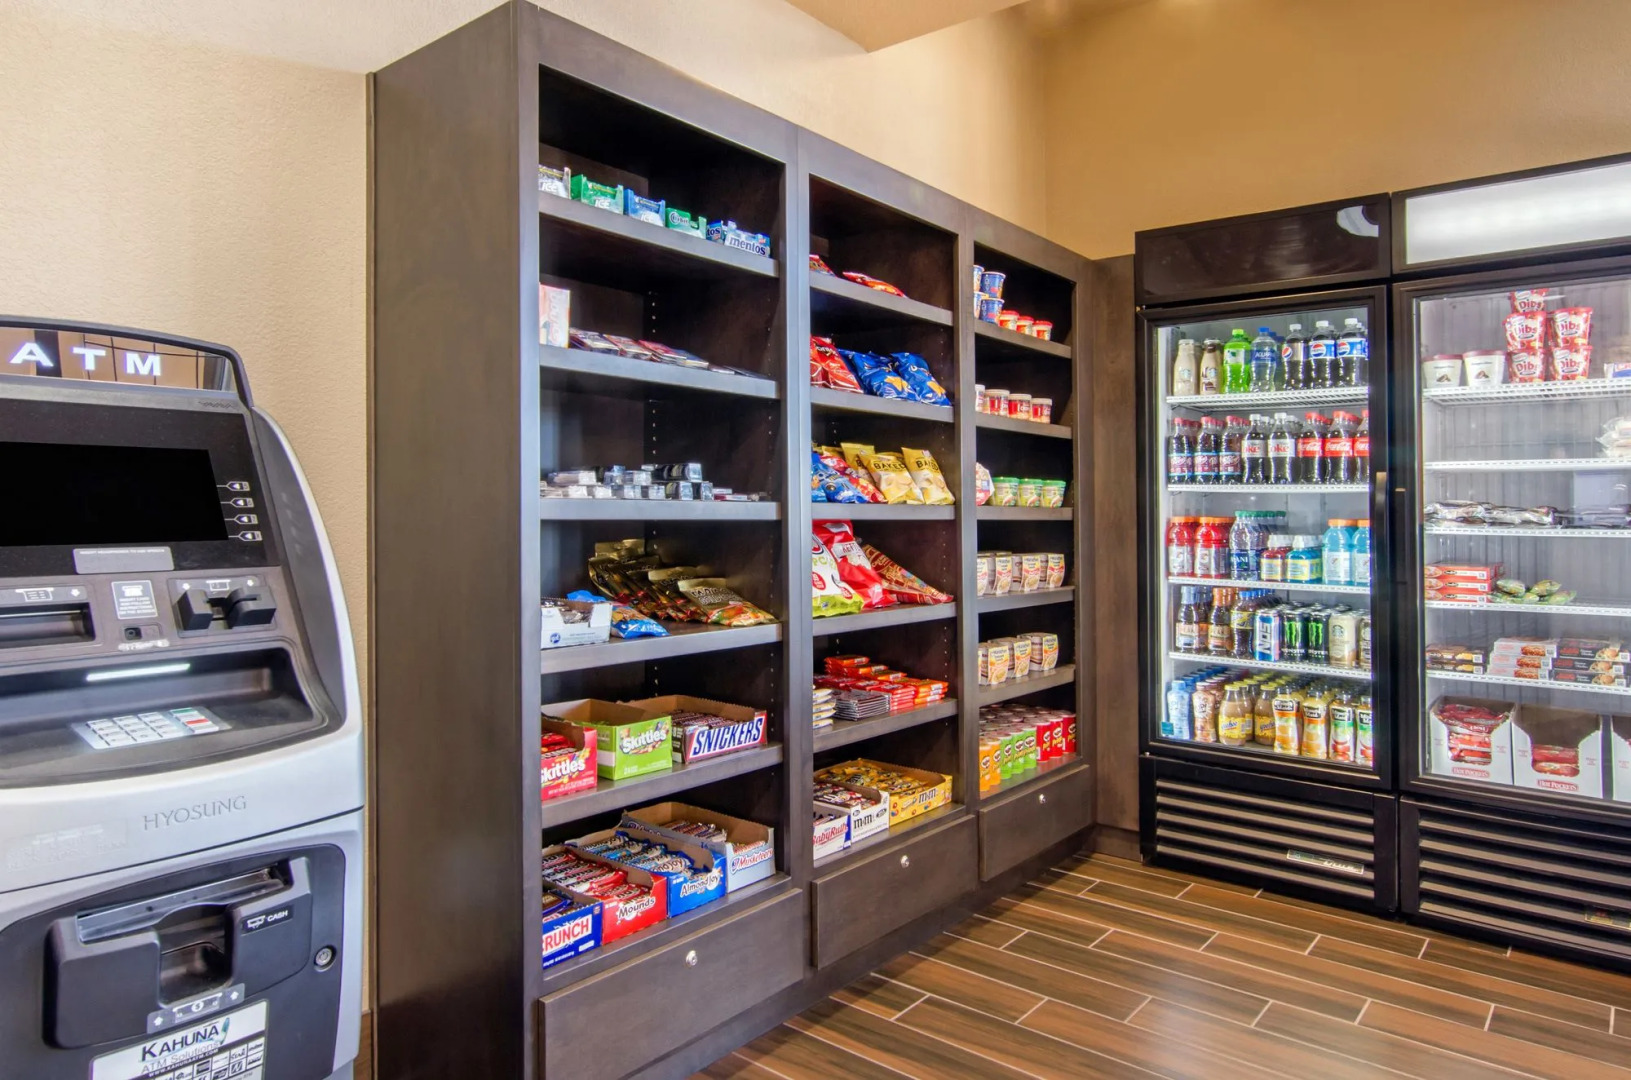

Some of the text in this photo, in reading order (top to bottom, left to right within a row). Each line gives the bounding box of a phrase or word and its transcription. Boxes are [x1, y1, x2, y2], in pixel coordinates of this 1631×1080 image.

[729, 236, 766, 256] mentos
[1519, 299, 1542, 310] Dibs
[9, 342, 162, 377] ATM
[1258, 621, 1272, 655] NOS
[622, 728, 668, 753] Skittles
[692, 717, 764, 756] SNICKERS
[142, 795, 248, 831] HYOSUNG
[681, 872, 721, 898] Almond Joy
[267, 910, 288, 922] CASH
[618, 896, 655, 918] Mounds
[142, 1024, 220, 1062] KAHUNA
[141, 1042, 221, 1076] ATM Solutions
